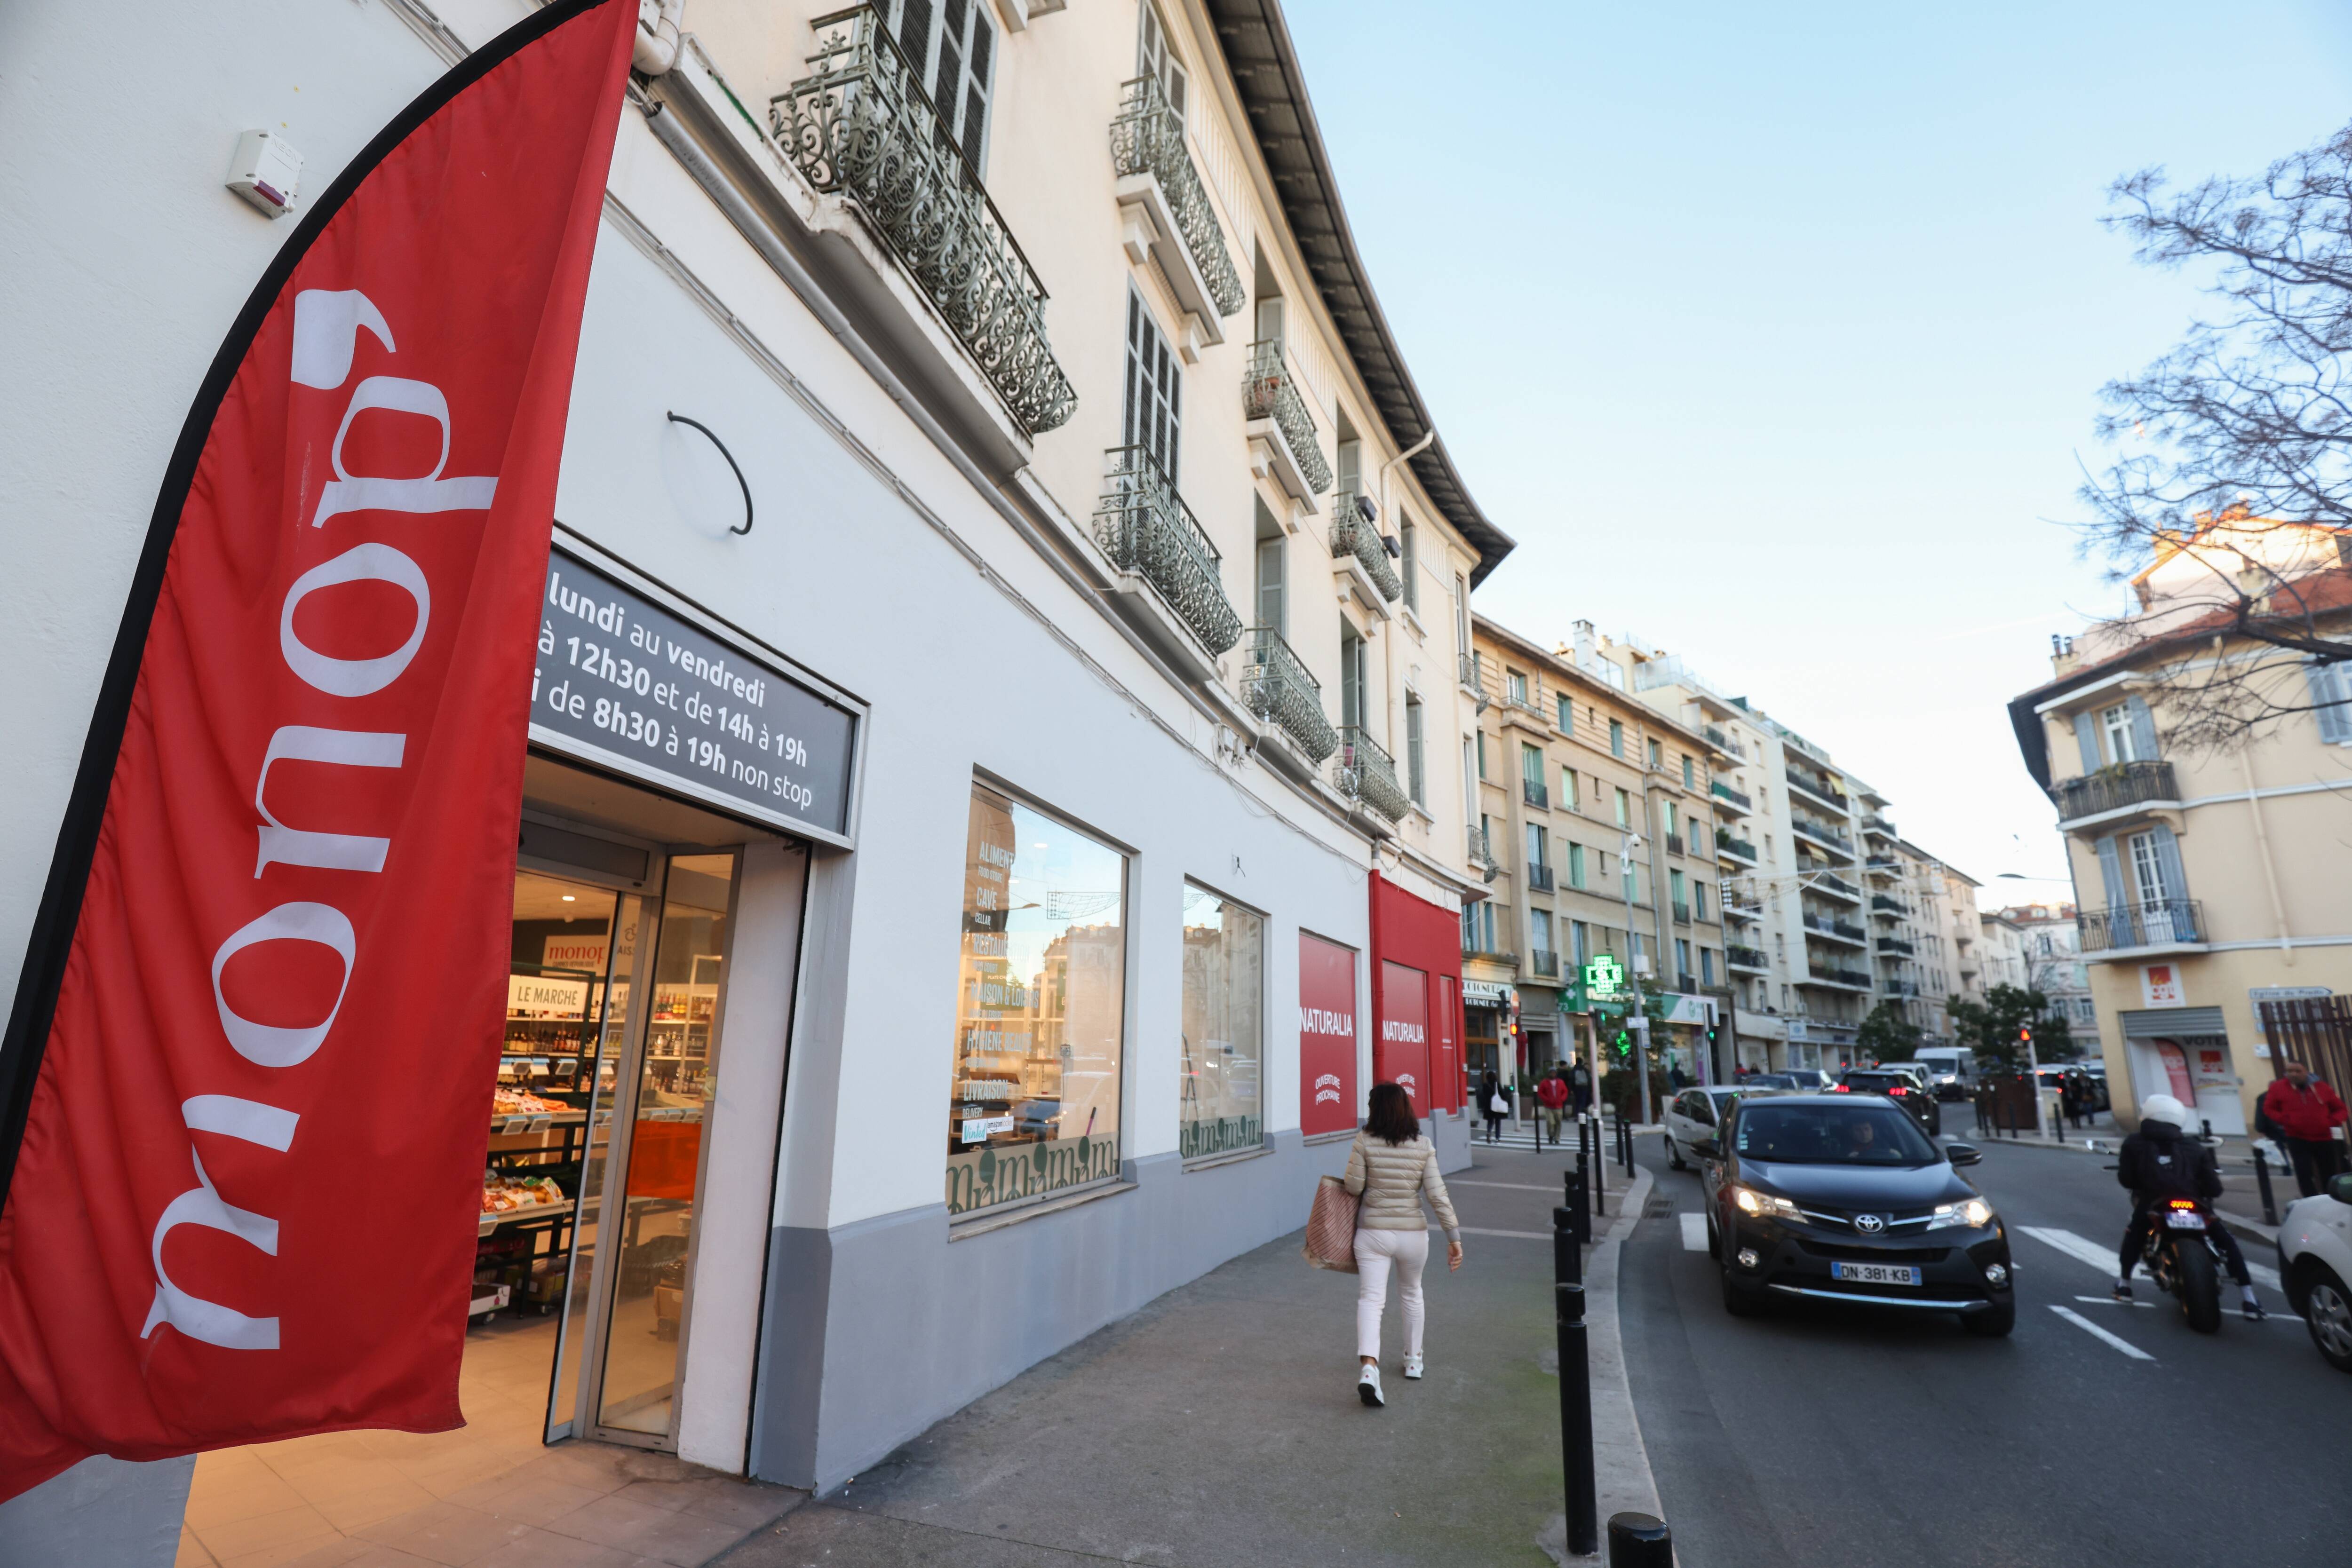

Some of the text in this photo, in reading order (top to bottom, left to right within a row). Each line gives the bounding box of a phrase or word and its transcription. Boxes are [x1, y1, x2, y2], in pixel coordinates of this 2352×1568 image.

[549, 571, 765, 708] lundi au vendredi
[538, 620, 555, 655] à
[567, 636, 650, 696] 12h30
[654, 683, 680, 711] et
[685, 691, 712, 725] de
[718, 706, 754, 744] 14h
[758, 723, 769, 751] à
[776, 734, 807, 767] 19h
[549, 680, 585, 719] de
[593, 698, 660, 747] 8h30
[665, 725, 679, 756] à
[687, 736, 726, 774] 19h
[731, 760, 769, 791] non
[773, 776, 812, 811] stop
[978, 865, 1002, 884] FOOD STORE
[975, 912, 991, 926] CELLAR
[517, 986, 531, 1002] LE
[1300, 1006, 1353, 1037] NATURALIA
[1382, 1020, 1425, 1044] NATURALIA
[963, 1079, 1009, 1101] LIVRAISON
[1315, 1074, 1340, 1090] OUVERTURE
[1316, 1089, 1340, 1106] PROCHAINE
[962, 1107, 984, 1119] DELIVERY
[964, 1123, 986, 1140] Vinted
